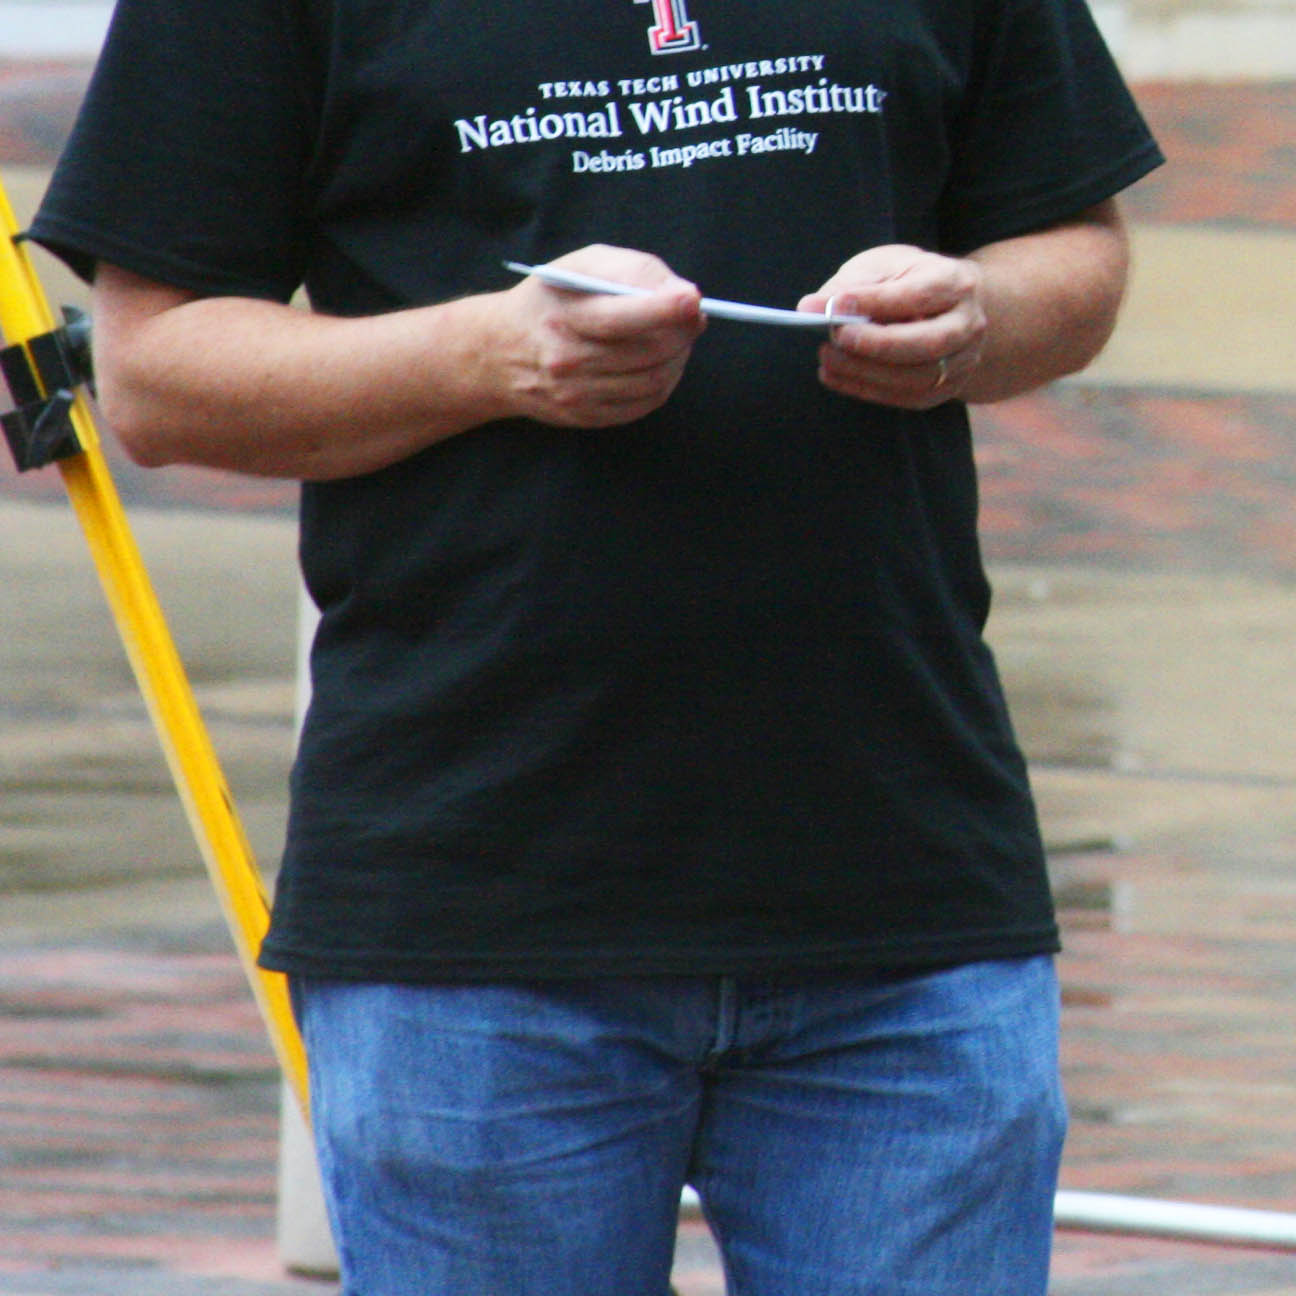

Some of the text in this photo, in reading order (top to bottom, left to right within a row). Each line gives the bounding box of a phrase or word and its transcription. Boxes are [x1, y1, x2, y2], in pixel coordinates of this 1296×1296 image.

[538, 54, 825, 99] TEXAS TECH UNIVERSITY
[454, 101, 623, 153] National
[628, 86, 737, 135] Wind
[572, 127, 819, 174] Debris Impact Facility
